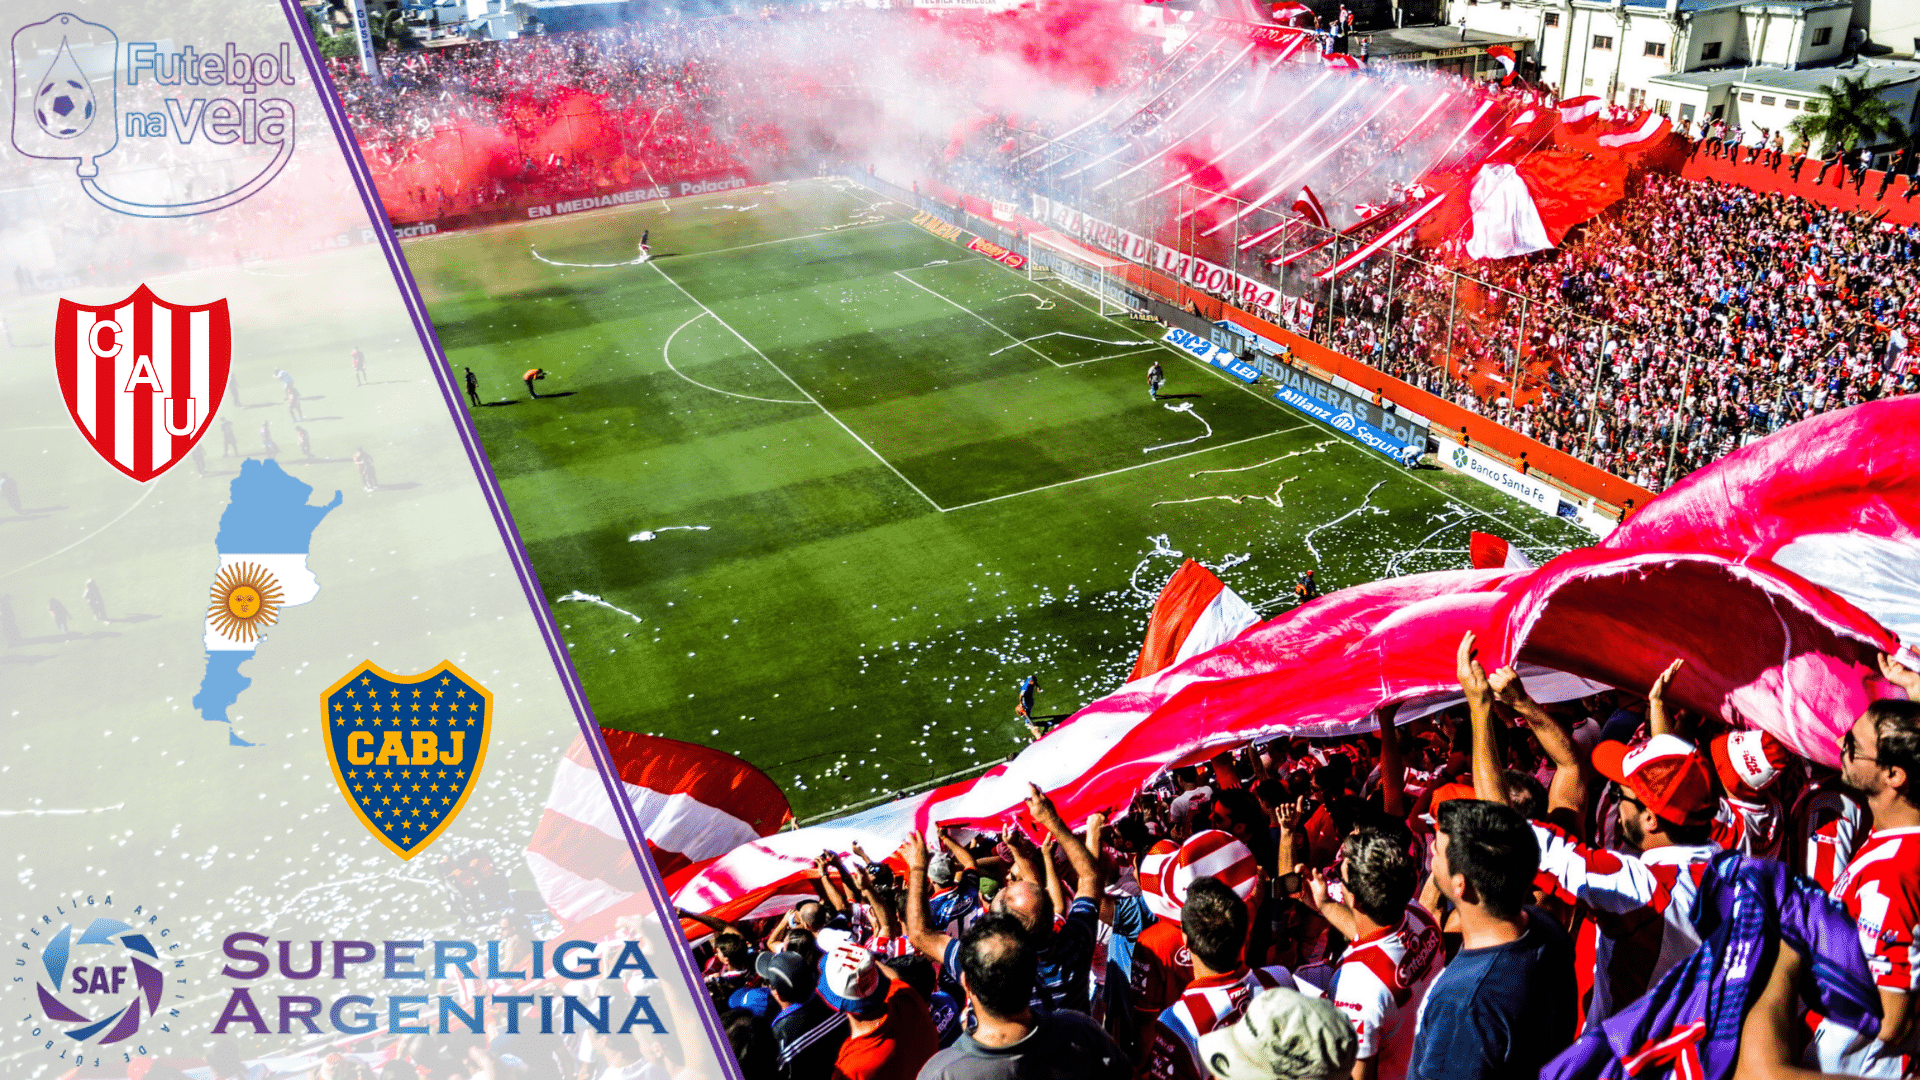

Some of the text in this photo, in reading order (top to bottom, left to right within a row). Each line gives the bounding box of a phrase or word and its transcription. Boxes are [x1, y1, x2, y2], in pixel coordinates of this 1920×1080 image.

[527, 175, 747, 219] EN MEDIANERAS Polacrin
[1132, 236, 1161, 266] DE
[1162, 250, 1192, 279] LA
[1191, 260, 1276, 307] BOMBA
[1210, 327, 1233, 352] EN
[1230, 361, 1259, 381] LED
[1278, 388, 1333, 420] Allianz
[1470, 458, 1545, 503] Banco Santa Fe
[1398, 930, 1440, 986] Sinteplast
